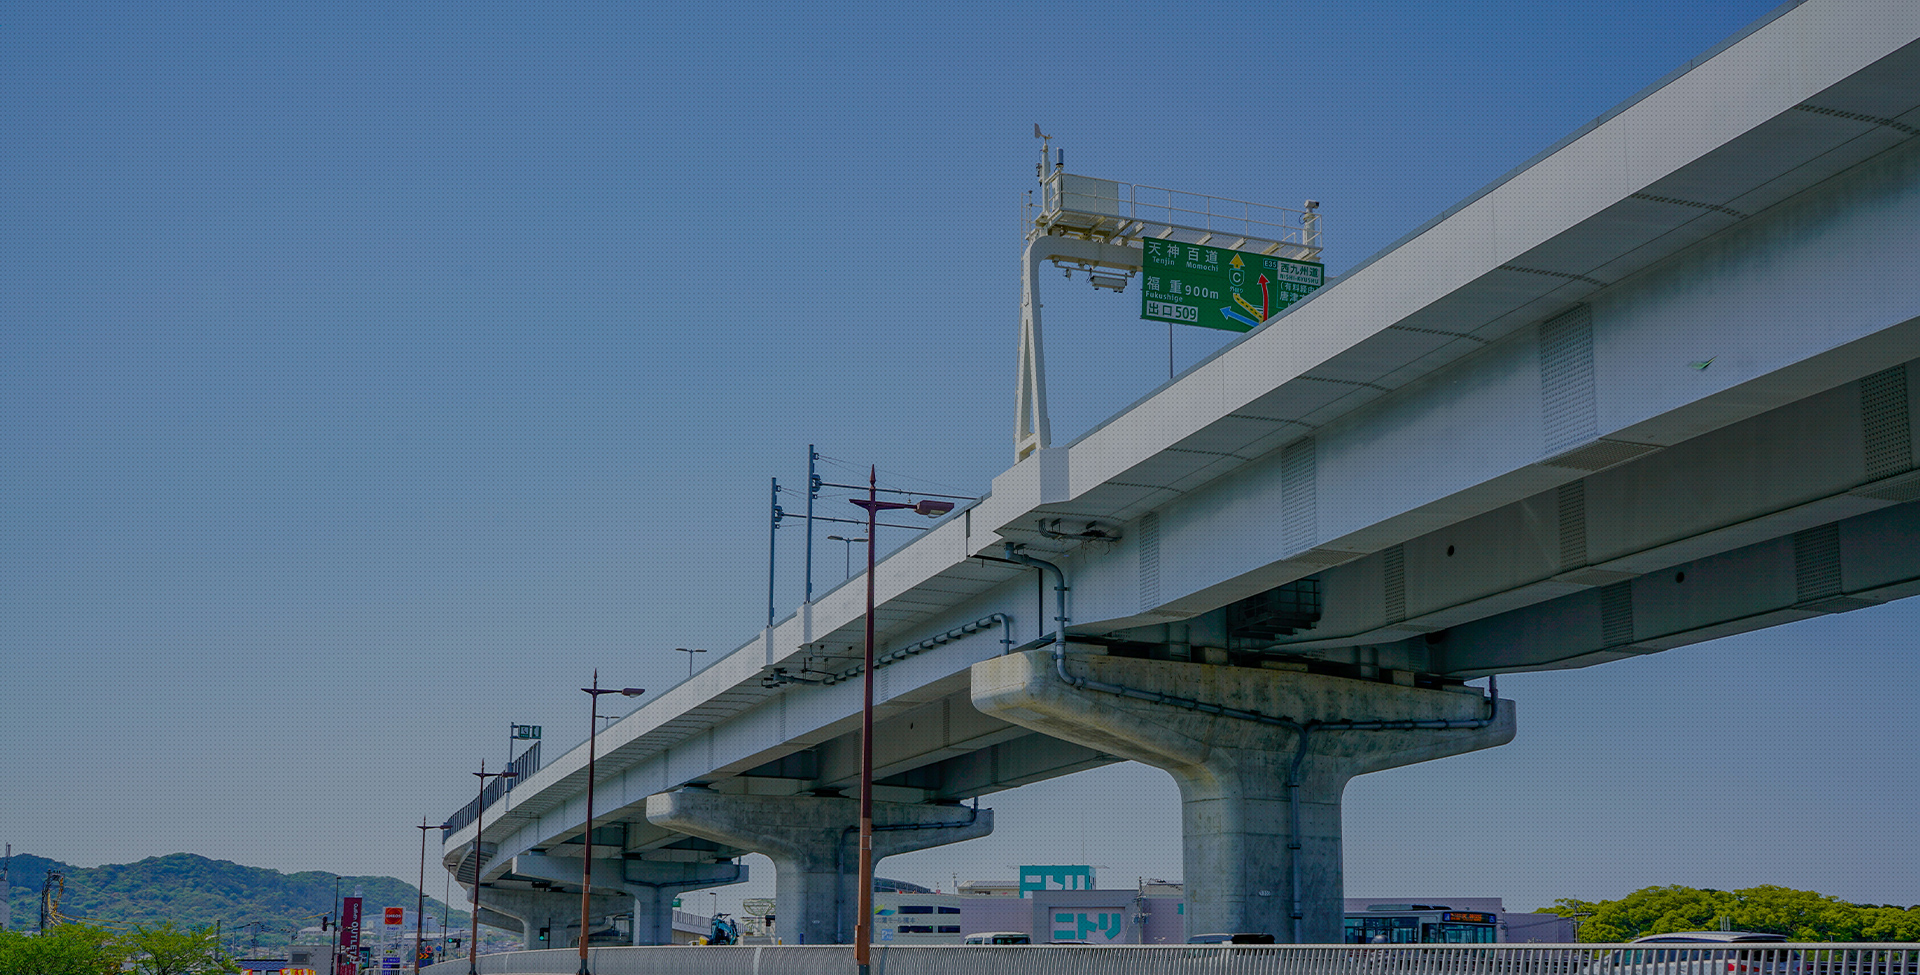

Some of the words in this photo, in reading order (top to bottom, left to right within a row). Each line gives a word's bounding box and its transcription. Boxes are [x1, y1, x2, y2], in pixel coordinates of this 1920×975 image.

[1152, 256, 1175, 267] Tenjin
[1186, 261, 1219, 272] Momochi
[1264, 260, 1277, 268] E35
[1280, 262, 1318, 278] 西九州道
[1232, 272, 1241, 283] C
[1279, 273, 1319, 284] NISHI-KYUSHU
[1145, 291, 1183, 303] Fukushige
[1185, 285, 1219, 300] 900m
[1148, 302, 1173, 317] 出口
[1175, 306, 1197, 321] 509
[1054, 913, 1121, 940] ニトリ
[349, 921, 359, 955] OUTLET
